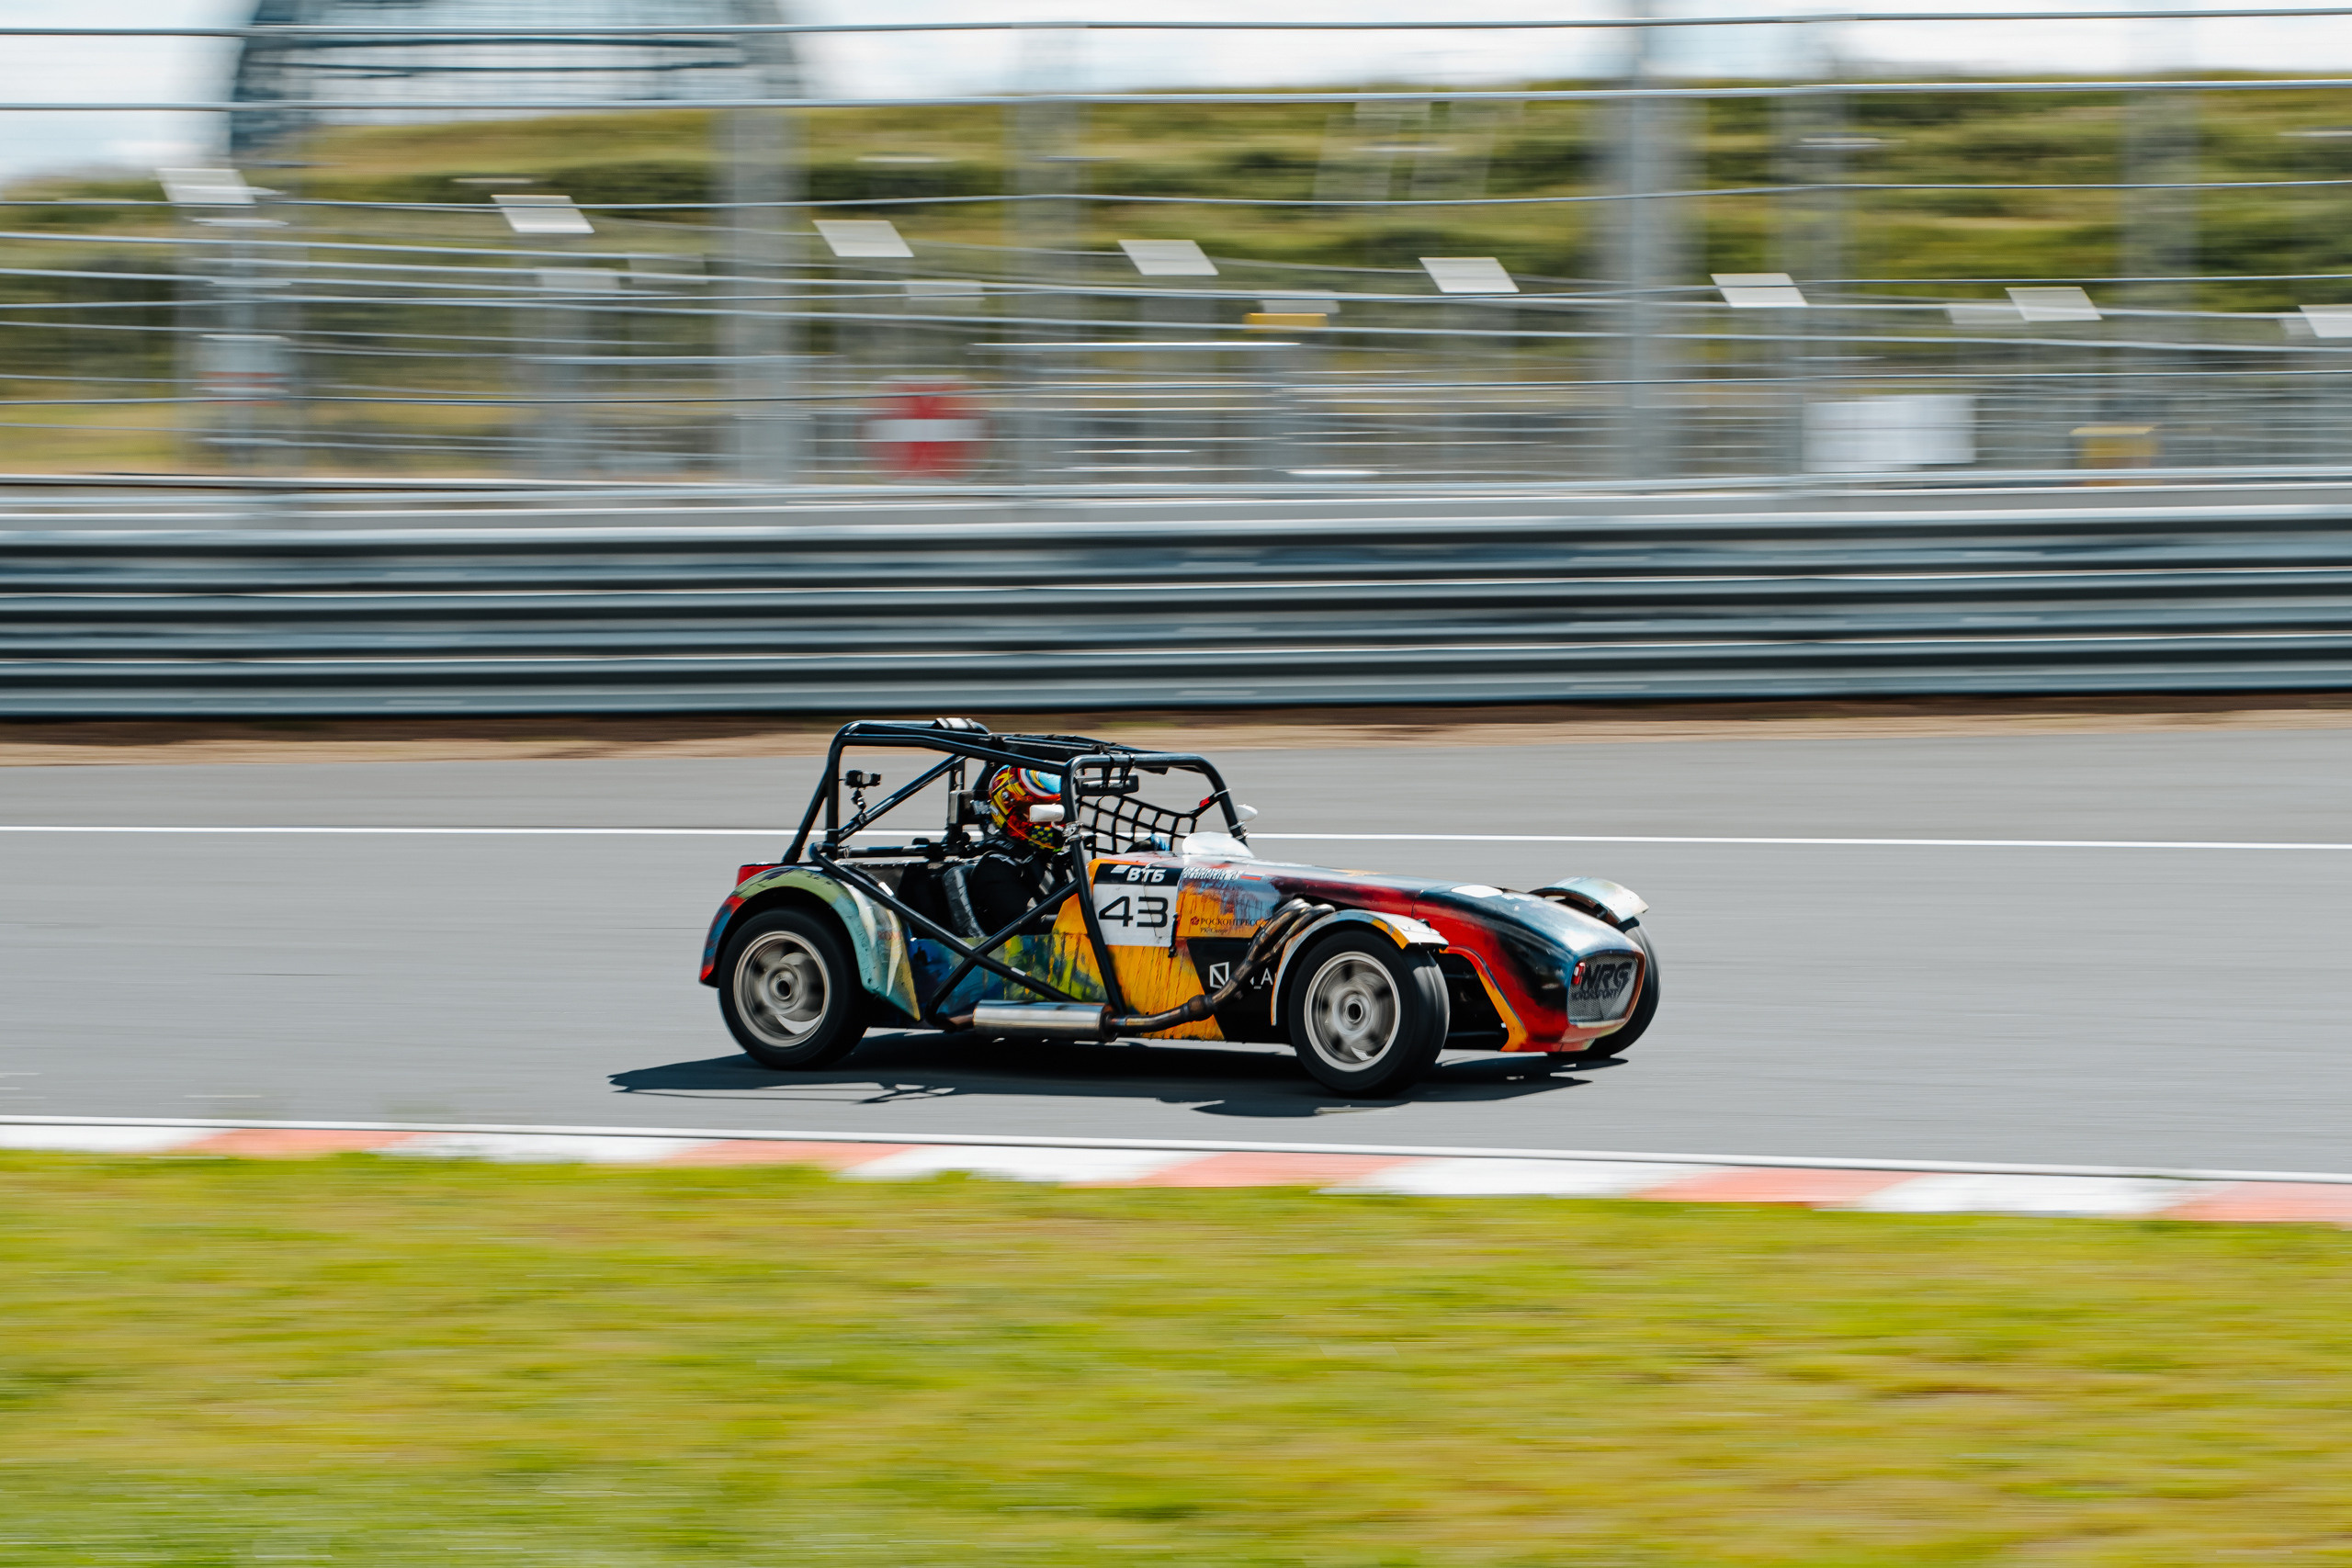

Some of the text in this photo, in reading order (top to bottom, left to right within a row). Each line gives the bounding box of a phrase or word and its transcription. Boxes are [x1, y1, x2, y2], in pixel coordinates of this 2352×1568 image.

[1126, 866, 1167, 883] ВТБ
[1098, 896, 1169, 928] 43
[1580, 962, 1632, 998] NRG
